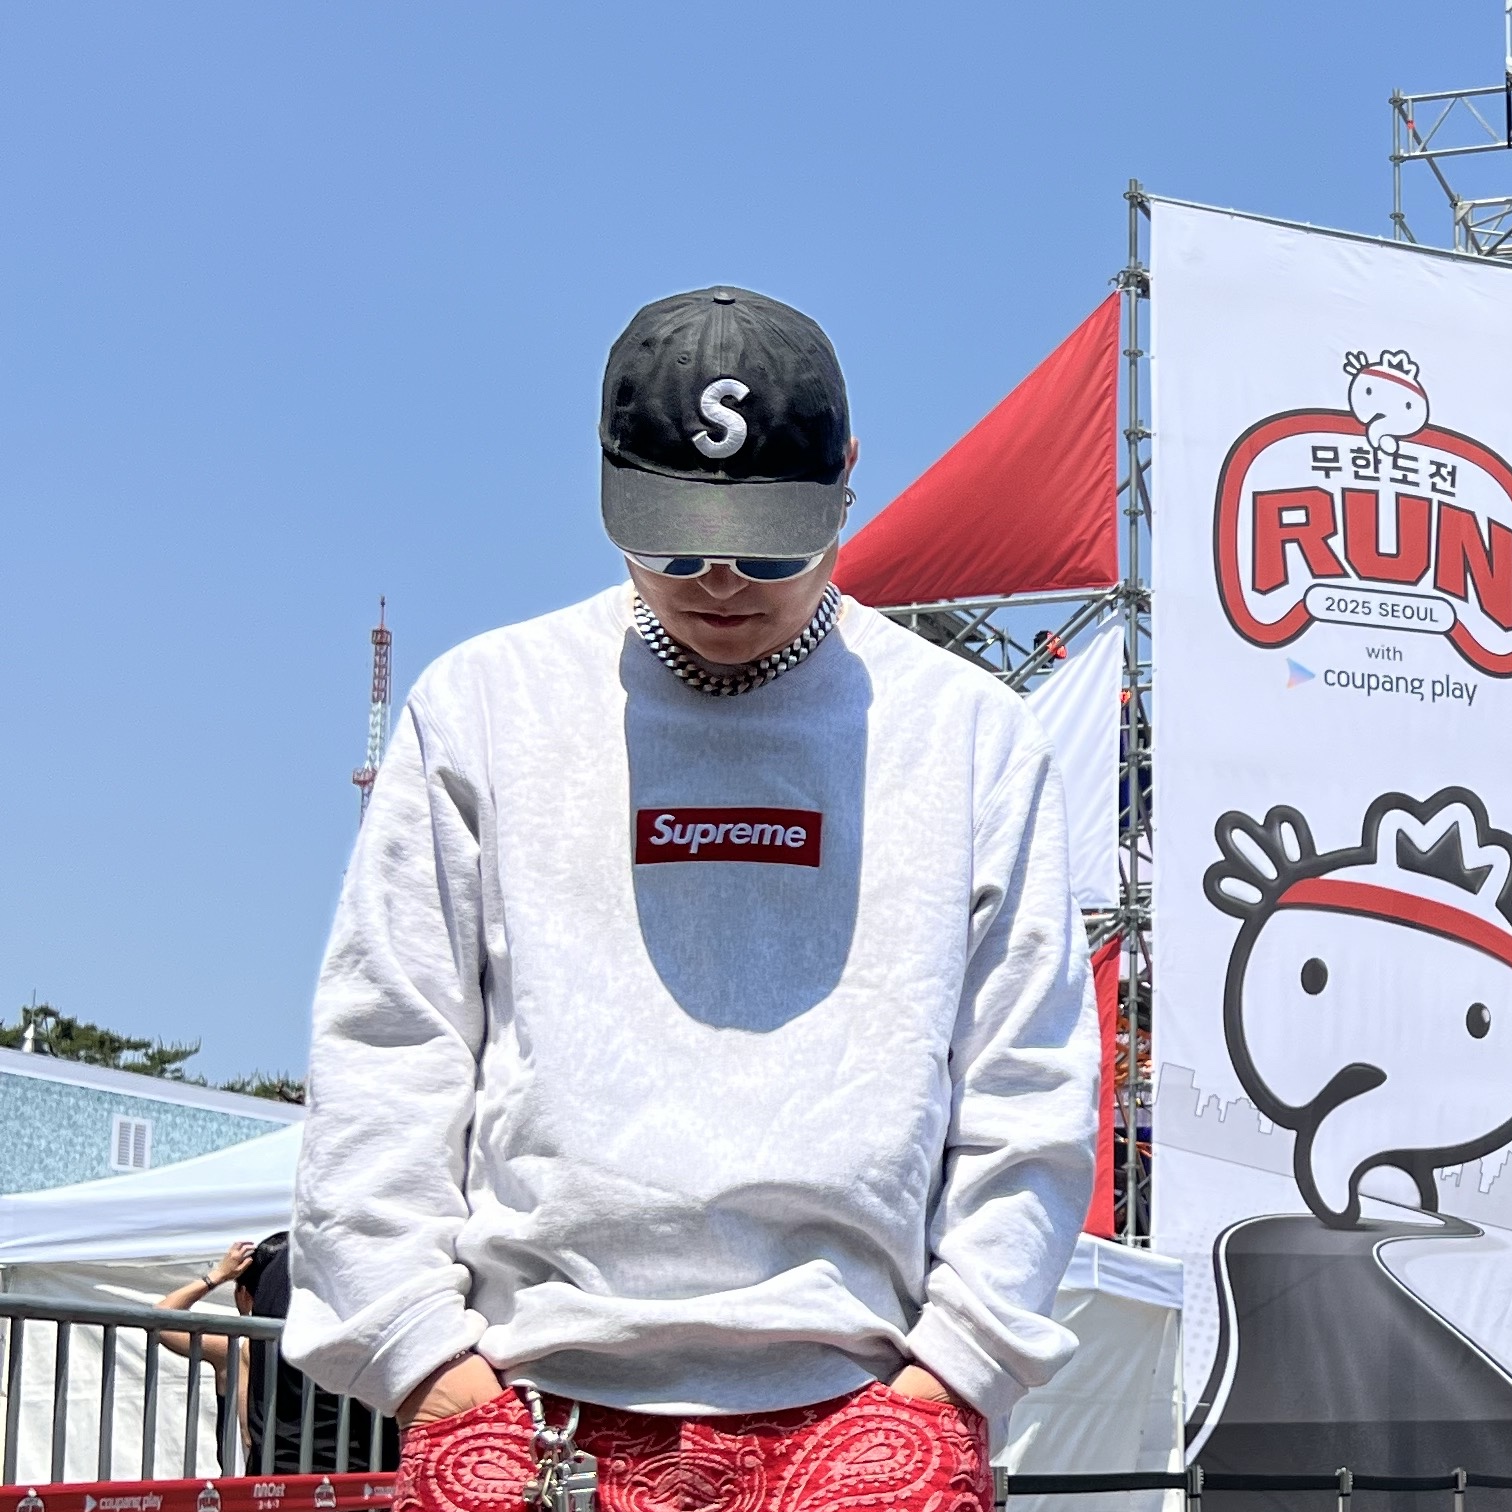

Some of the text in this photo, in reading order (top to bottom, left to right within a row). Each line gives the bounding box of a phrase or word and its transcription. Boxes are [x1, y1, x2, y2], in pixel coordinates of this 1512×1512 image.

[691, 378, 750, 459] S
[1311, 445, 1458, 498] 무한도전
[1325, 596, 1439, 623] 2025 SEOUL
[1365, 644, 1403, 662] with
[1324, 669, 1478, 706] coupang play
[650, 813, 807, 854] Supreme
